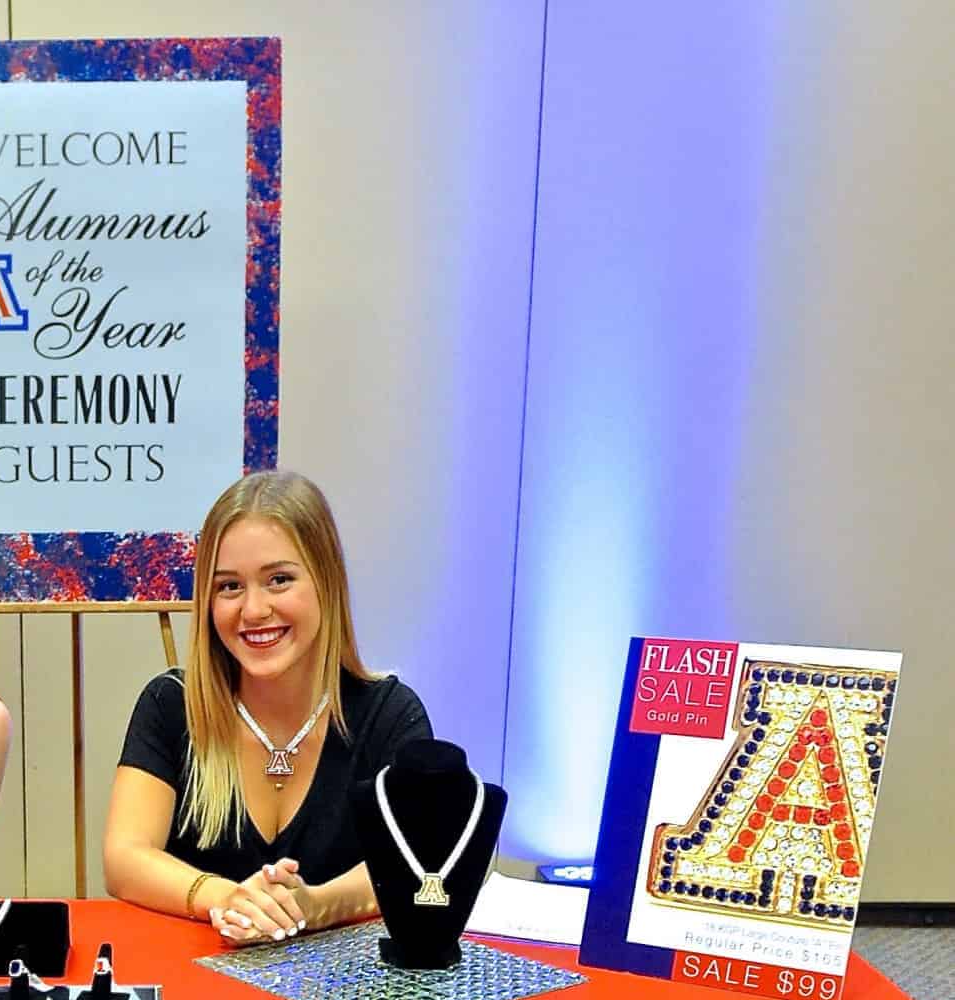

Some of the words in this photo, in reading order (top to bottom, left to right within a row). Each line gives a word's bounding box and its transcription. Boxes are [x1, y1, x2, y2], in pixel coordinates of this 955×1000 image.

[25, 250, 64, 297] of
[61, 251, 103, 283] the
[33, 286, 185, 360] Year
[641, 644, 733, 676] FLASH
[637, 676, 726, 708] SALE
[646, 709, 679, 722] Gold
[685, 712, 708, 725] Pin
[685, 931, 744, 951] Regular
[752, 941, 793, 960] Price
[801, 949, 842, 967] $165
[682, 954, 763, 989] SALE
[776, 968, 837, 1000] $99
